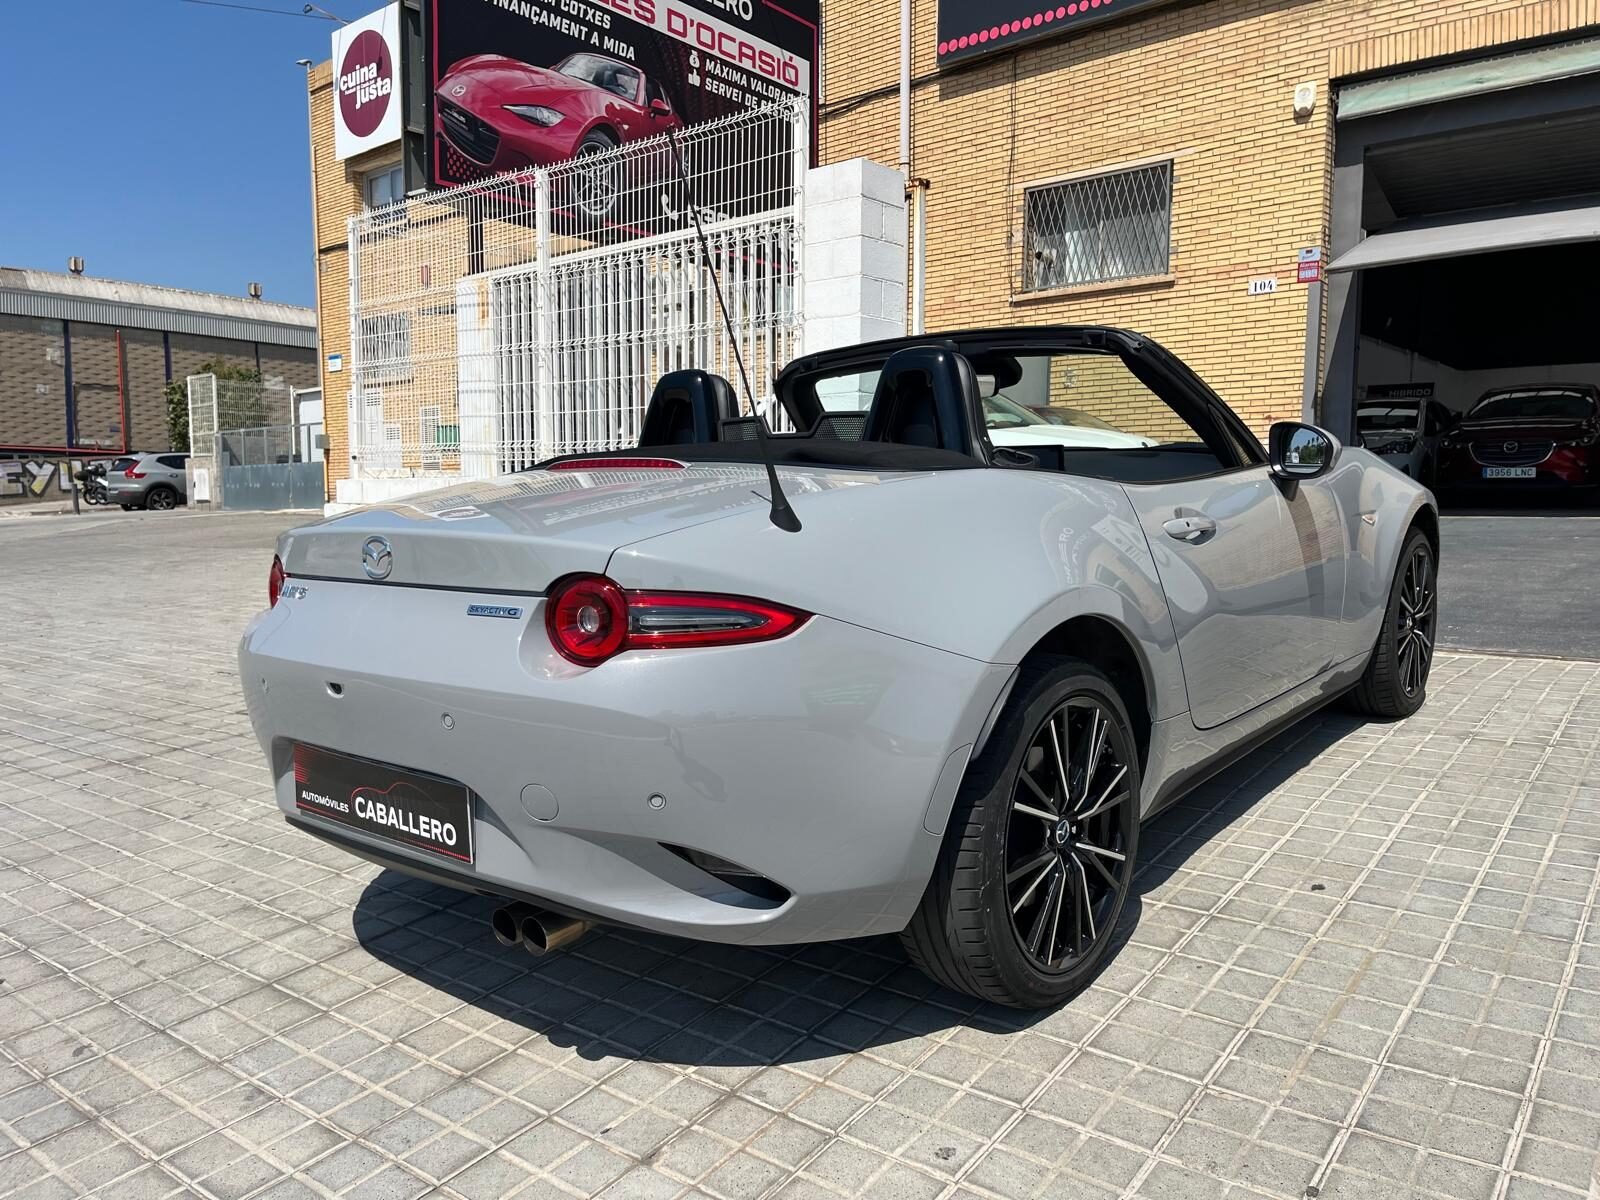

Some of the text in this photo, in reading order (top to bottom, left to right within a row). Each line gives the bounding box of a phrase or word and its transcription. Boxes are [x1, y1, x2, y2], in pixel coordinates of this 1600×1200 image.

[560, 0, 612, 30] COTXES
[590, 31, 600, 47] A
[603, 35, 635, 61] MIDA
[666, 7, 799, 87] D'OCASIÓ
[340, 62, 378, 91] cuina
[705, 58, 748, 88] MÀXIMA
[355, 77, 391, 110] justa
[705, 78, 742, 103] SERVEI
[745, 93, 758, 109] DE
[1254, 280, 1273, 292] 104
[1488, 468, 1533, 477] 3956 LNC
[302, 790, 457, 846] AUTOMÓVILES CABALLERO
